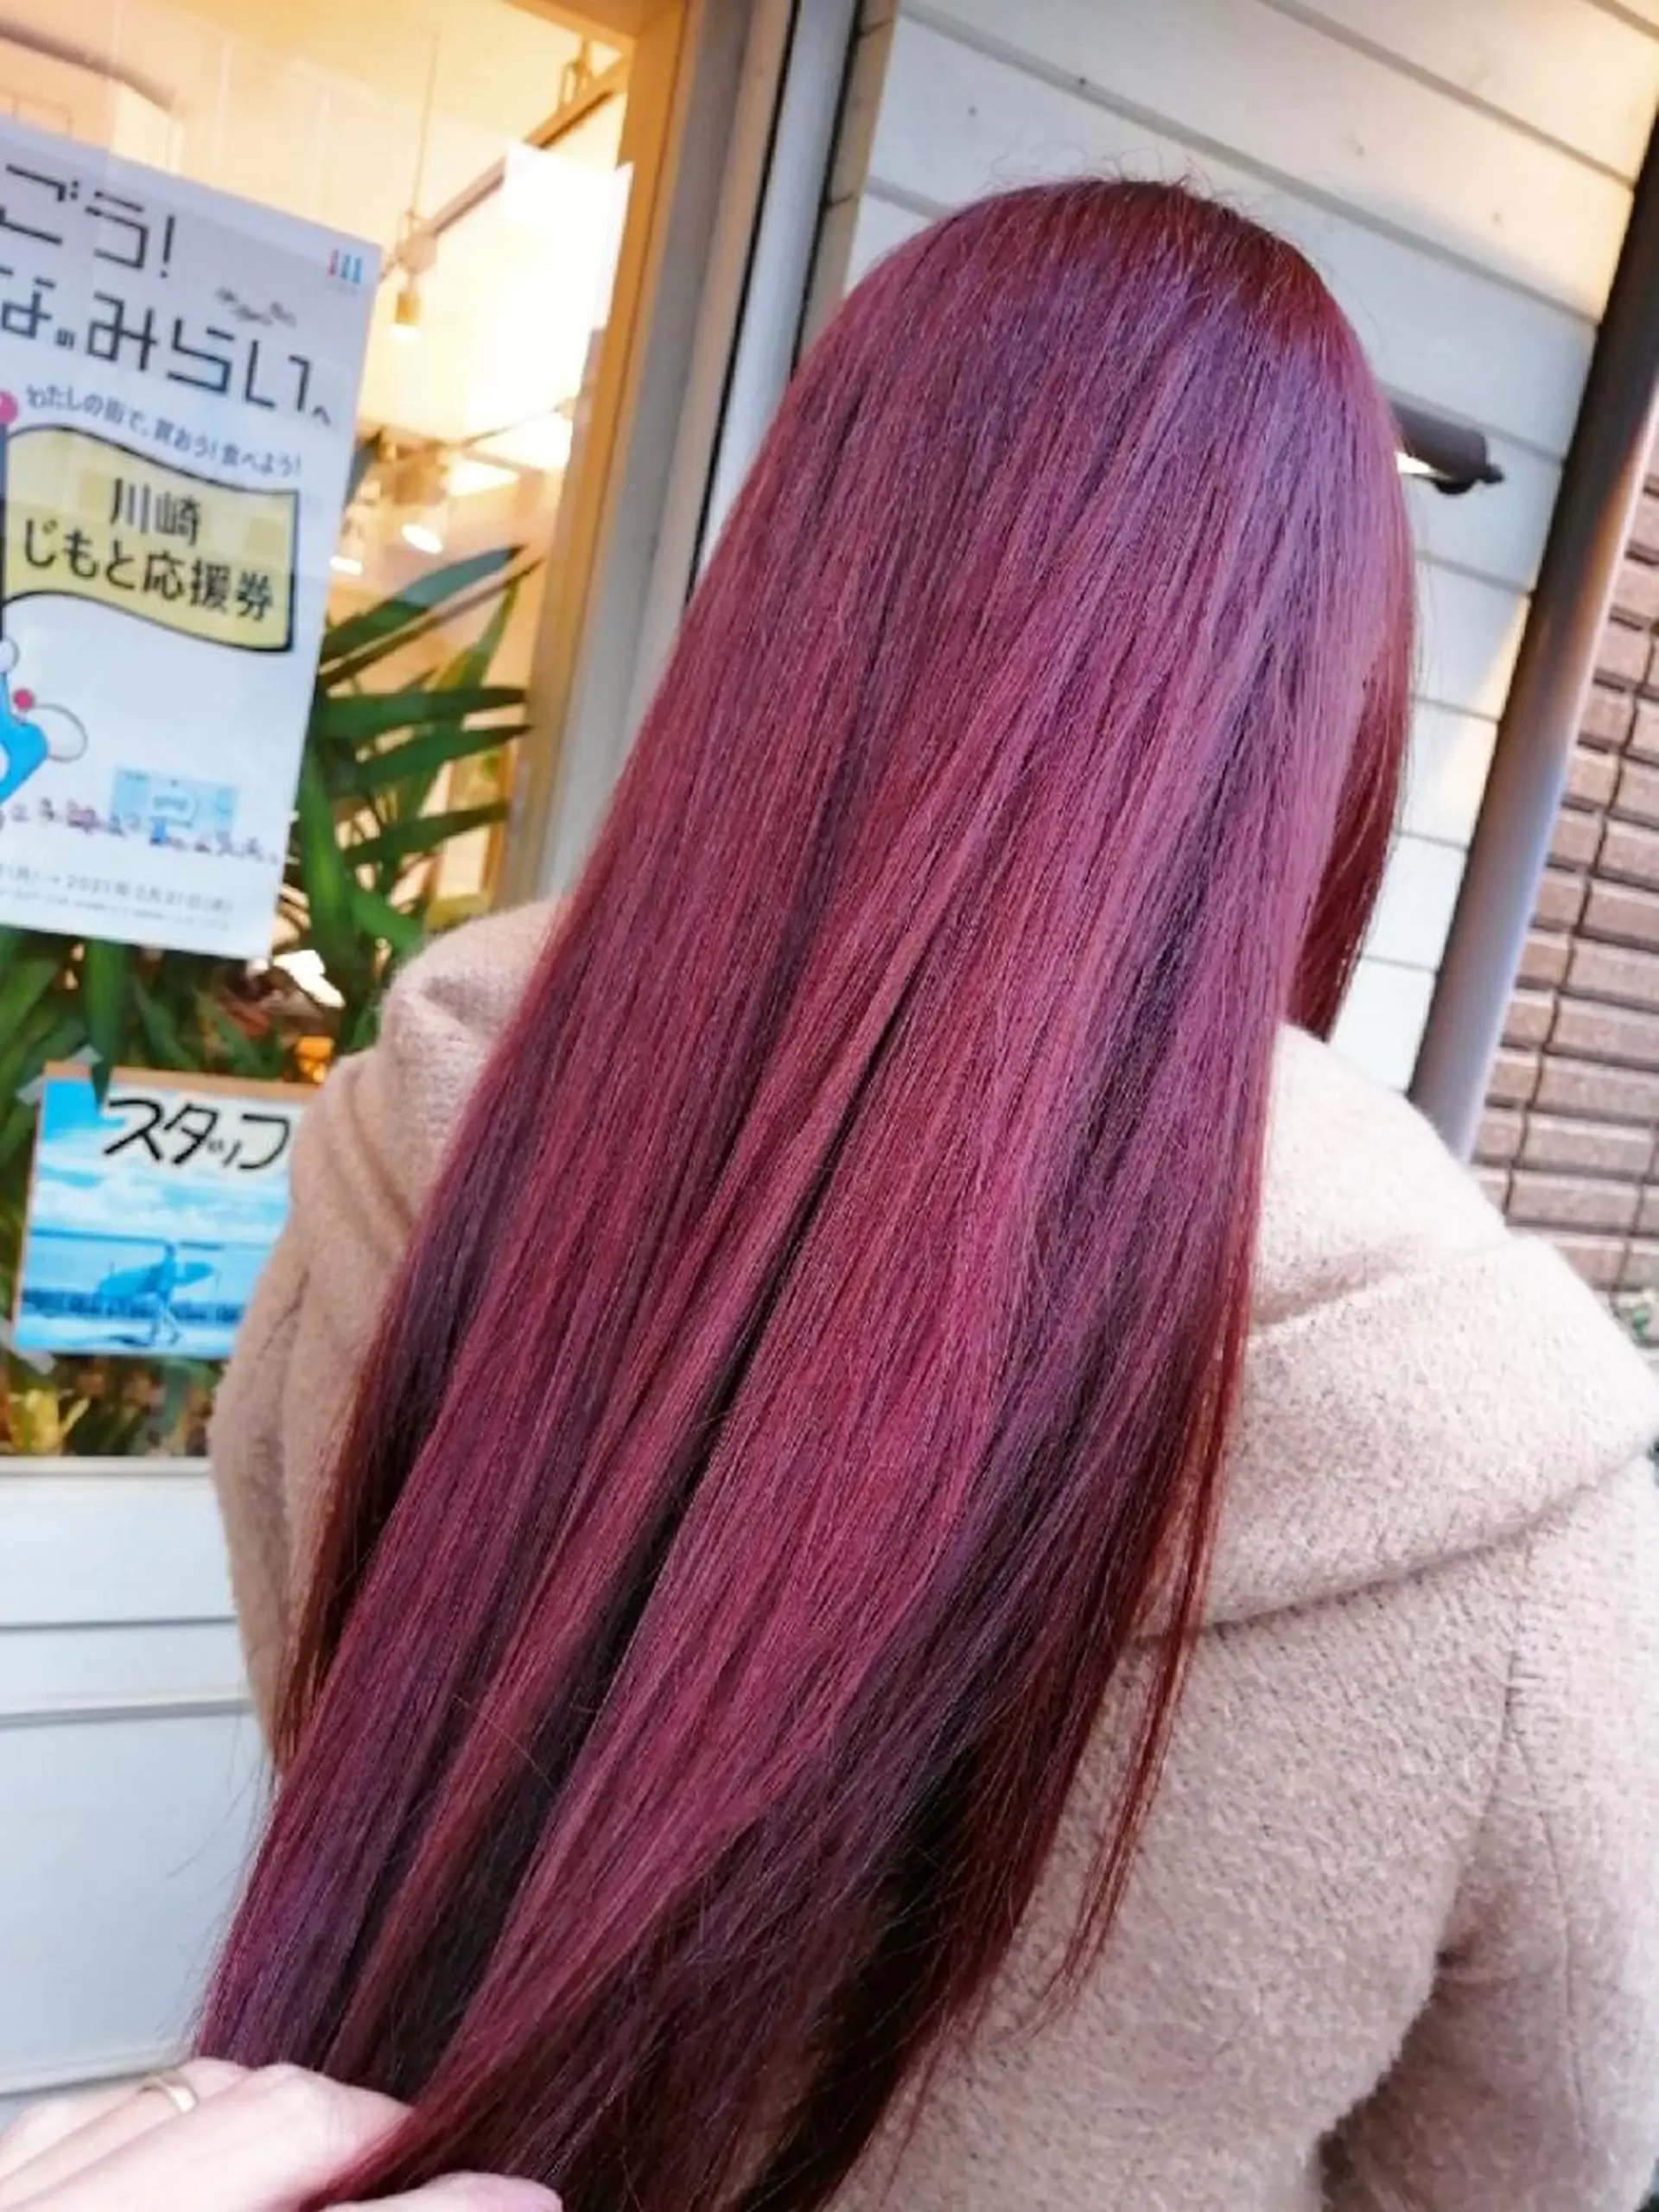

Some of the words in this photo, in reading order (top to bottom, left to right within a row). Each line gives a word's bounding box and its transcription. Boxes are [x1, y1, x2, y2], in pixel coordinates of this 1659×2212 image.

[110, 478, 201, 546] 川崎
[25, 518, 274, 622] じもと応援券
[103, 1096, 291, 1172] スタッフ
